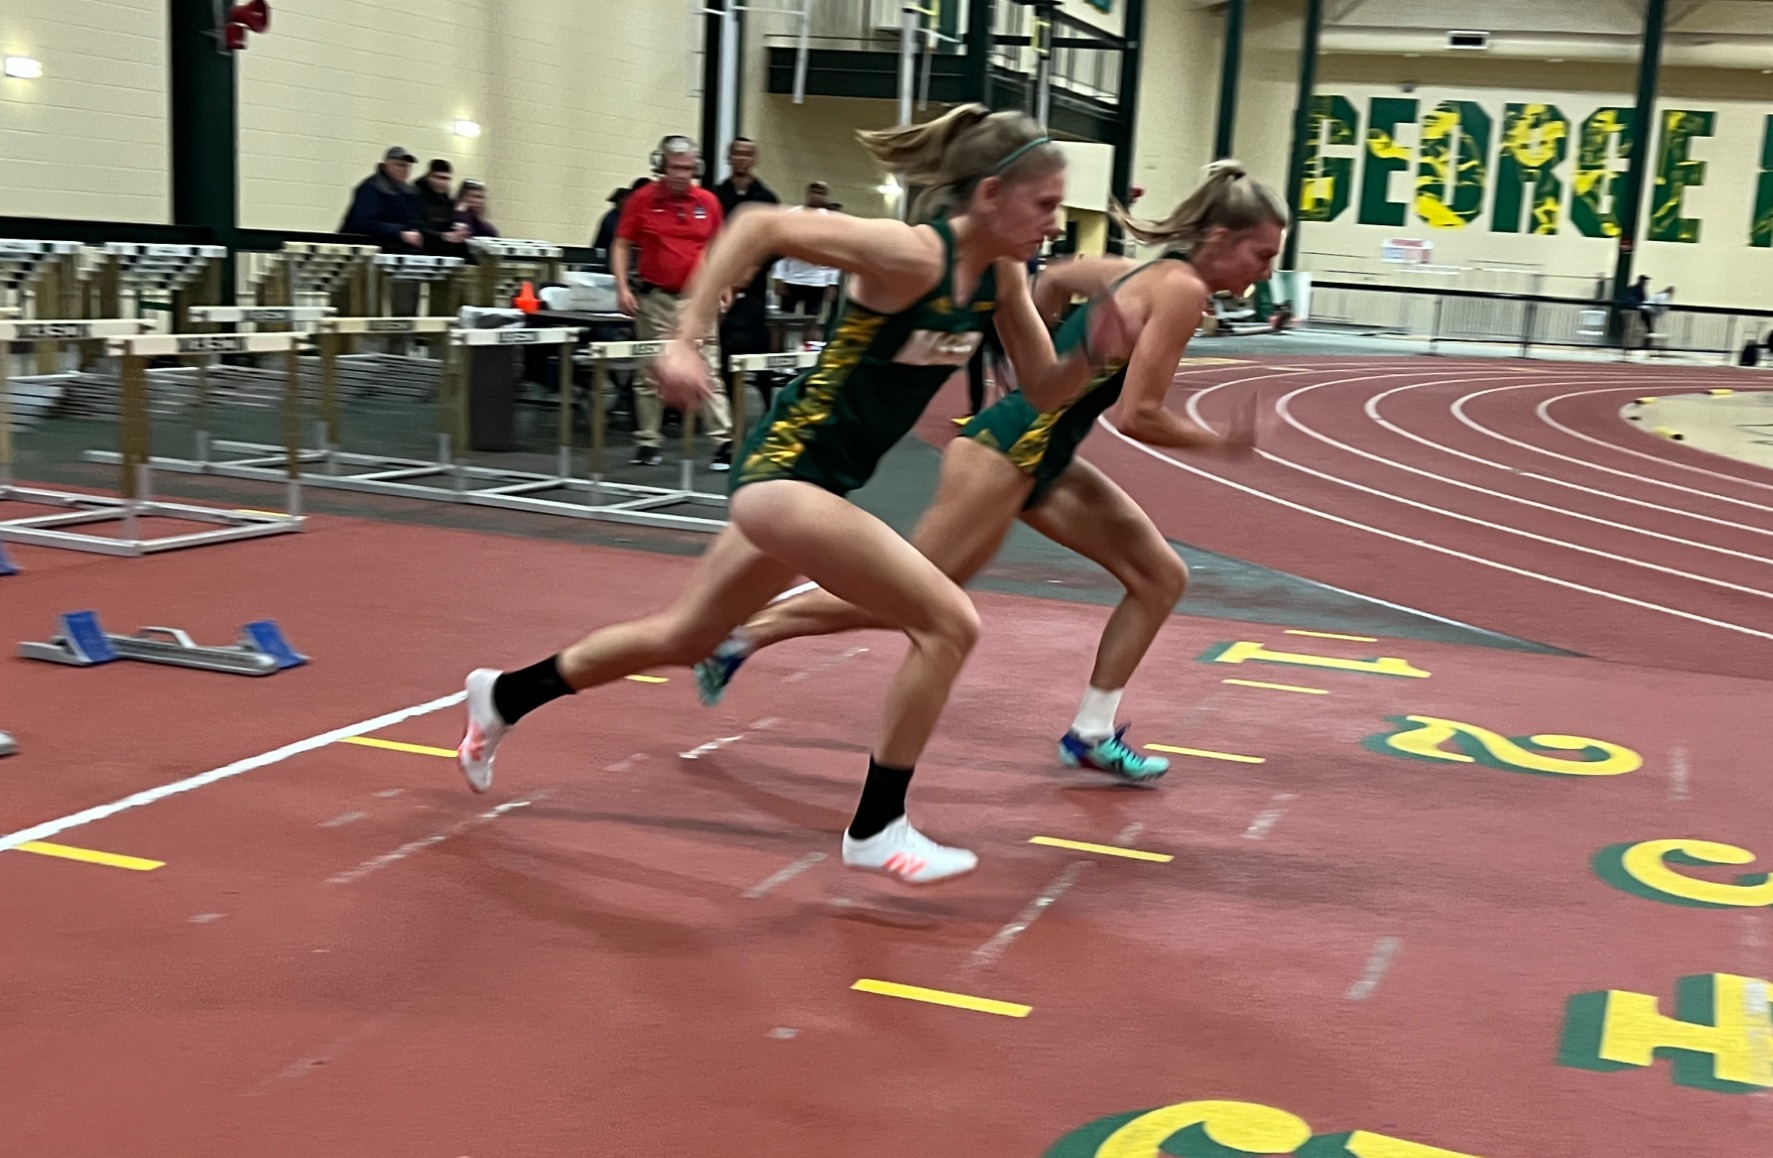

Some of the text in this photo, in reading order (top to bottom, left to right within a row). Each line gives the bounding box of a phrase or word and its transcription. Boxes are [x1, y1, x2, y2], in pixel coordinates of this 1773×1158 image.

[1297, 94, 1717, 243] GEORGE
[1214, 641, 1431, 678] 1
[1384, 714, 1644, 776] 2
